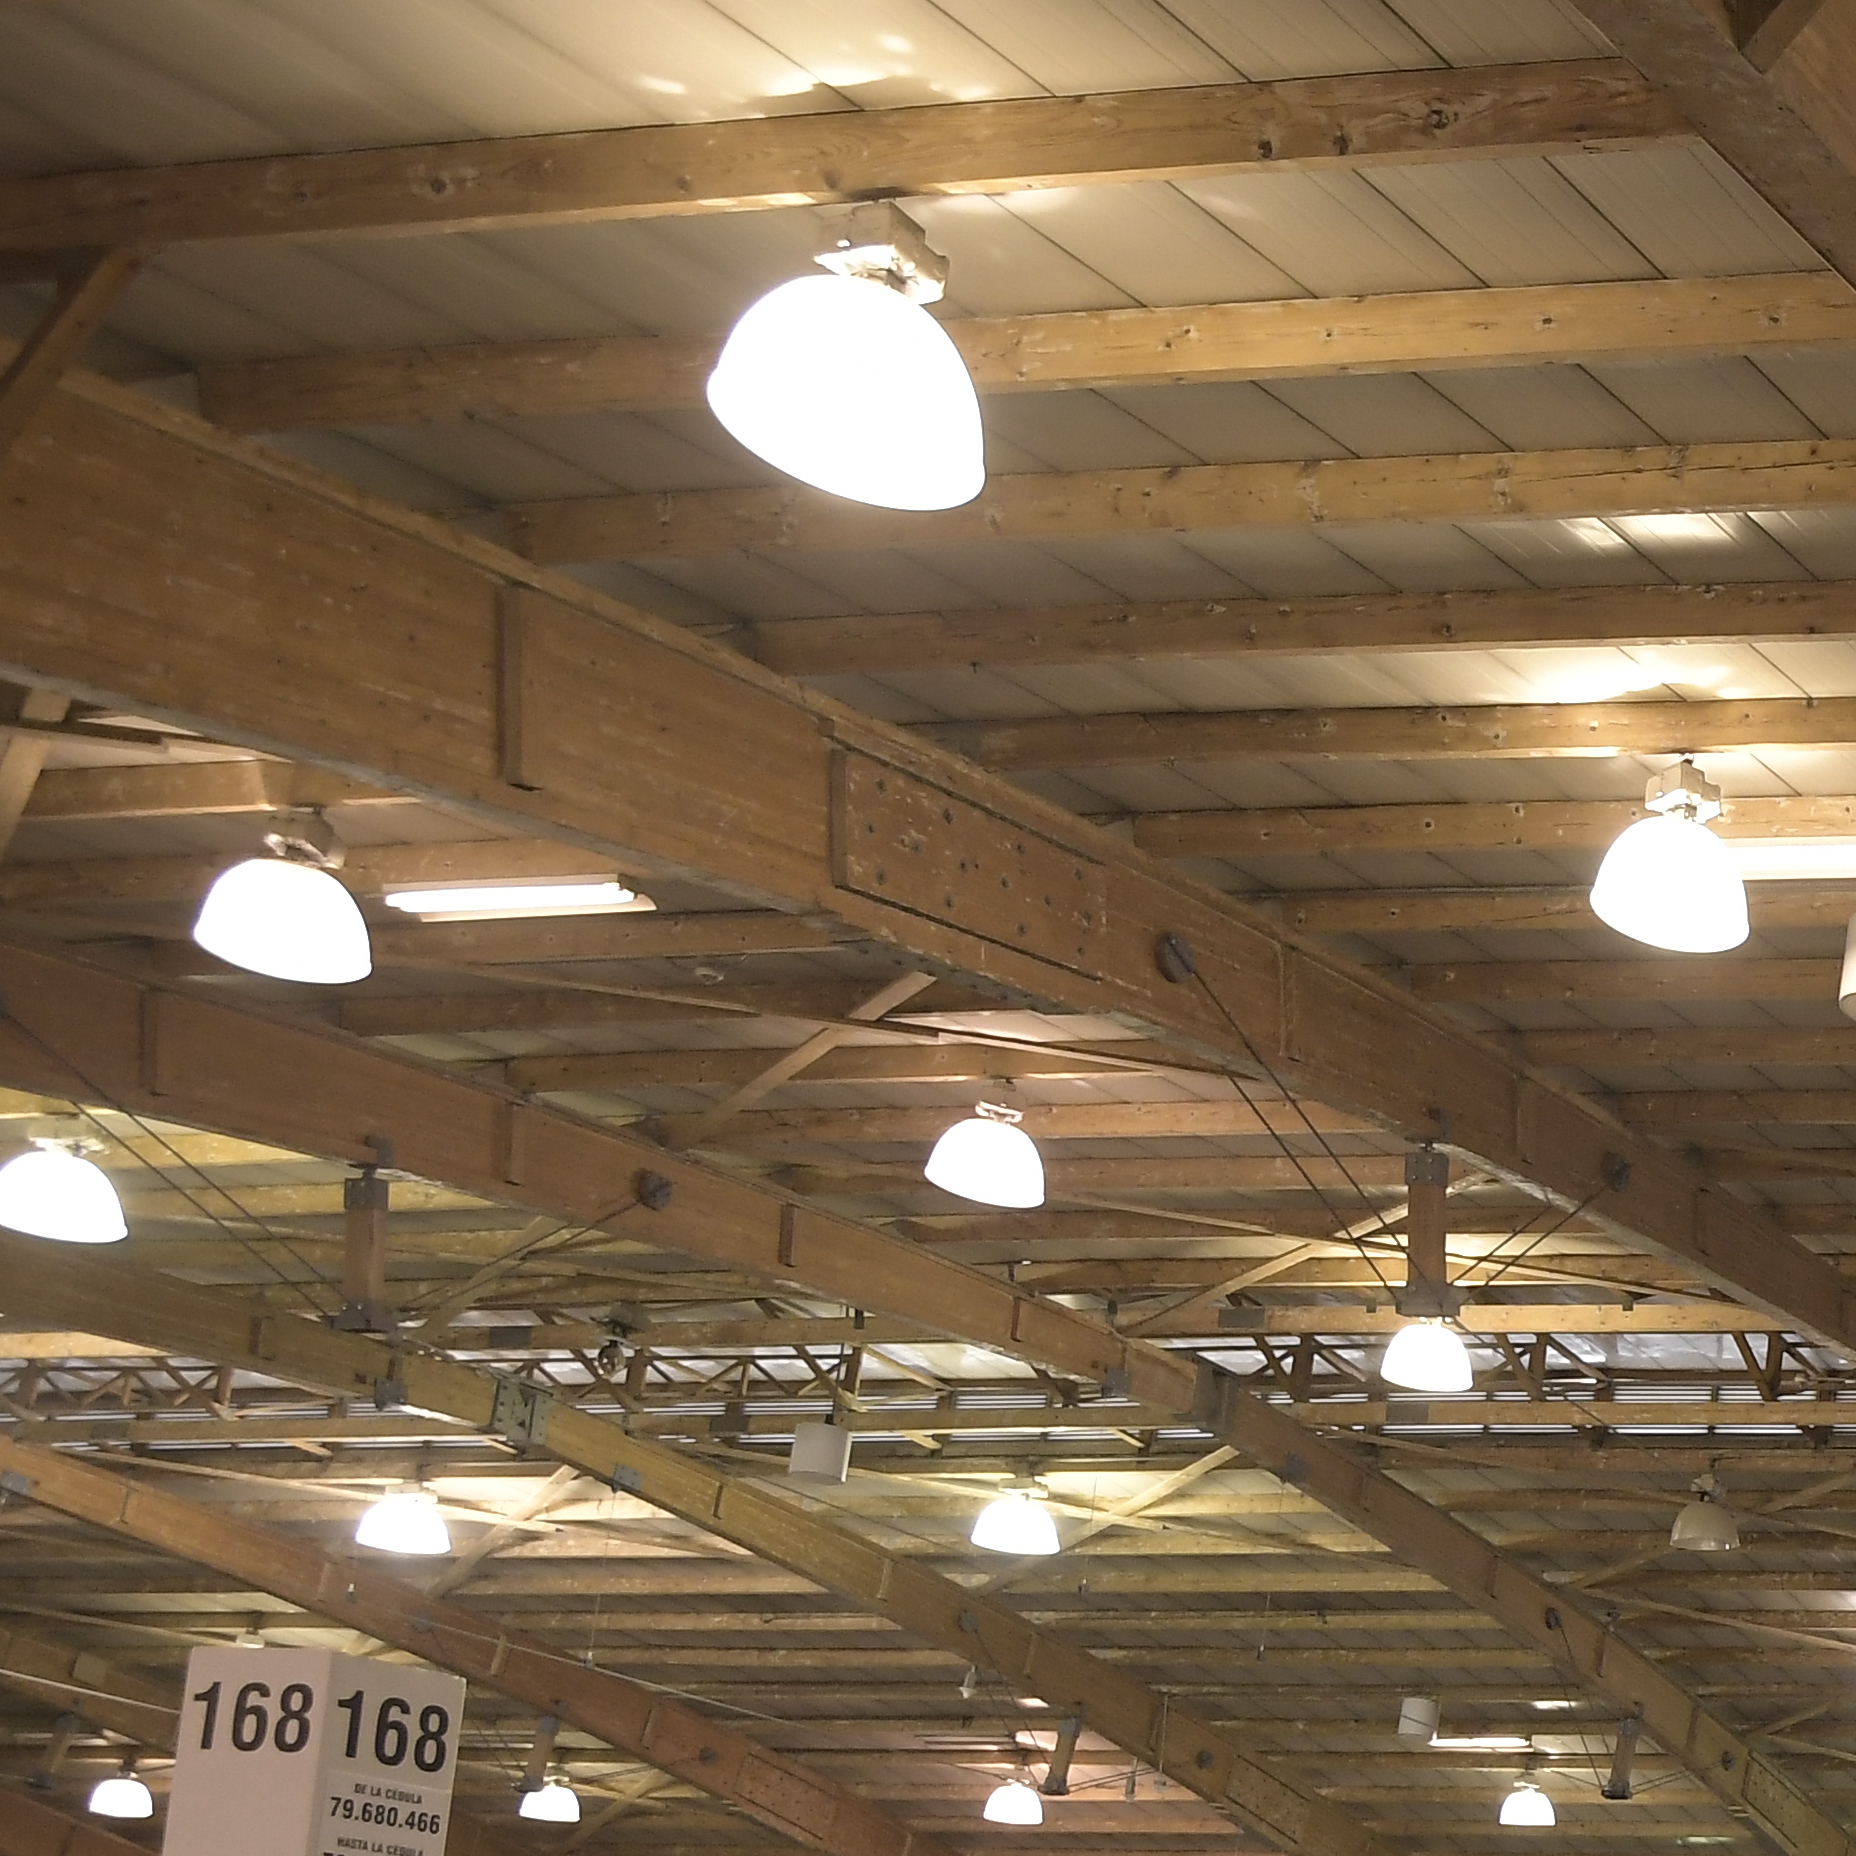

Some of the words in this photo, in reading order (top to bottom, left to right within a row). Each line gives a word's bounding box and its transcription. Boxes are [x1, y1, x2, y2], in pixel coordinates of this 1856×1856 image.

[193, 1681, 314, 1753] 168
[337, 1689, 450, 1773] 168
[354, 1782, 368, 1795] DE
[370, 1786, 382, 1797] LA
[329, 1796, 441, 1835] 79.680.466
[337, 1837, 368, 1851] HASTA
[371, 1842, 383, 1853] LA
